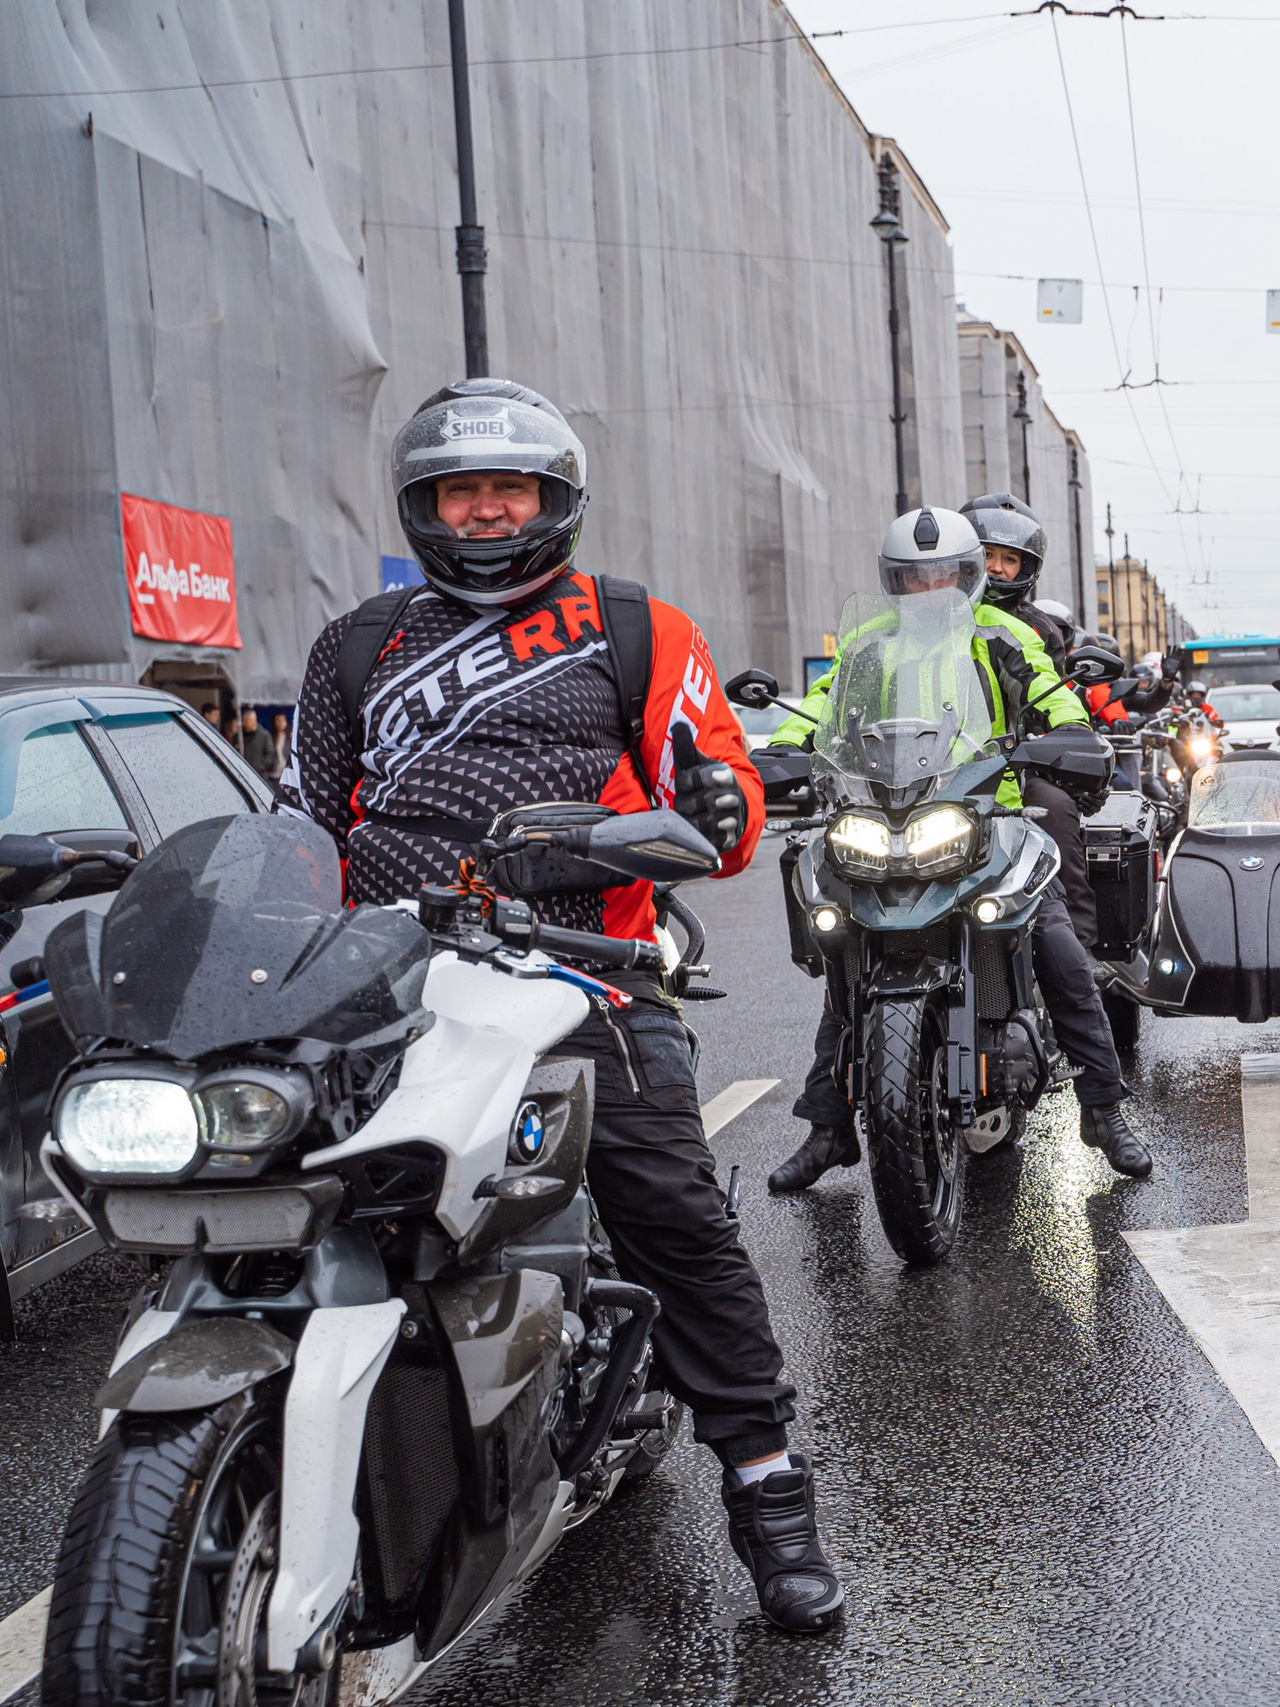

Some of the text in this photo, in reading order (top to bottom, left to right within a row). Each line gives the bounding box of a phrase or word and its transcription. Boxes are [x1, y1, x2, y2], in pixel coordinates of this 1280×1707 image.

[451, 421, 505, 437] SHOEI
[136, 552, 231, 602] Альфа Банк
